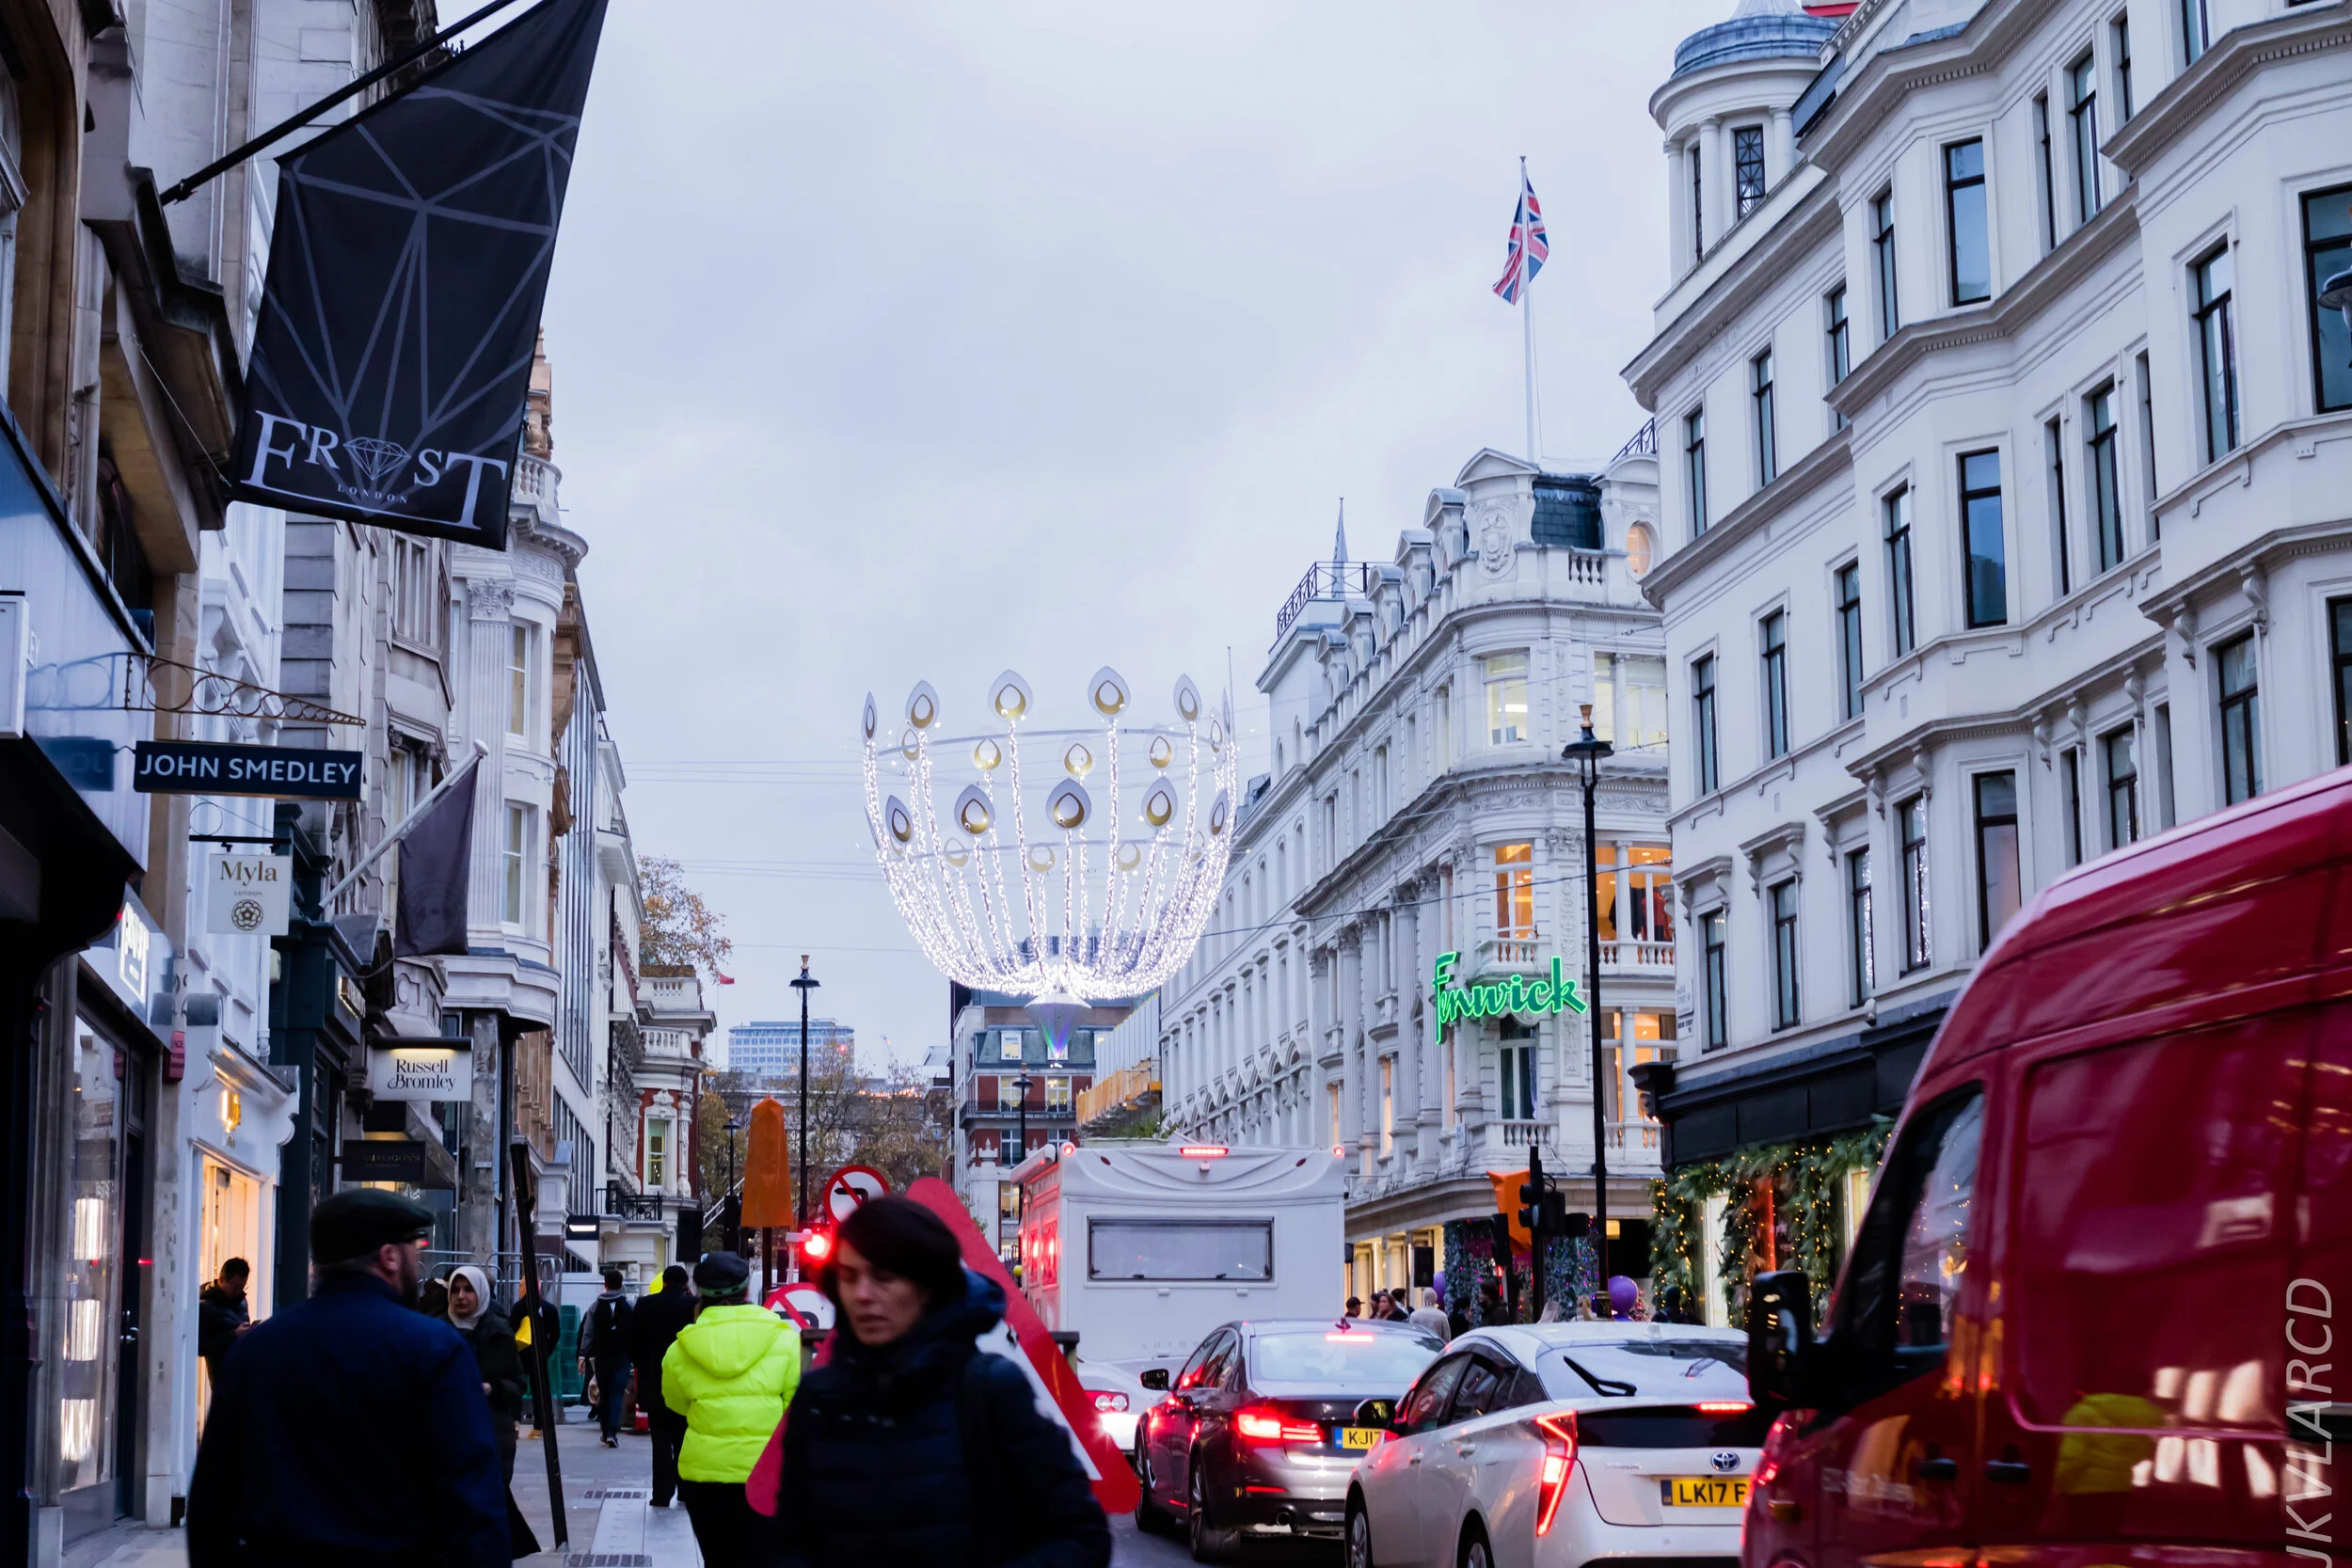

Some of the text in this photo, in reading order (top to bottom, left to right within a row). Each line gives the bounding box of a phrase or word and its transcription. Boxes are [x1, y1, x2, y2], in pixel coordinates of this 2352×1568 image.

[337, 483, 408, 504] LONDON
[140, 754, 357, 784] JOHN SMEDLEY
[220, 861, 278, 886] Myla
[1433, 951, 1588, 1045] Fenwick
[396, 1059, 449, 1073] Russell
[1679, 1483, 1727, 1503] LK17
